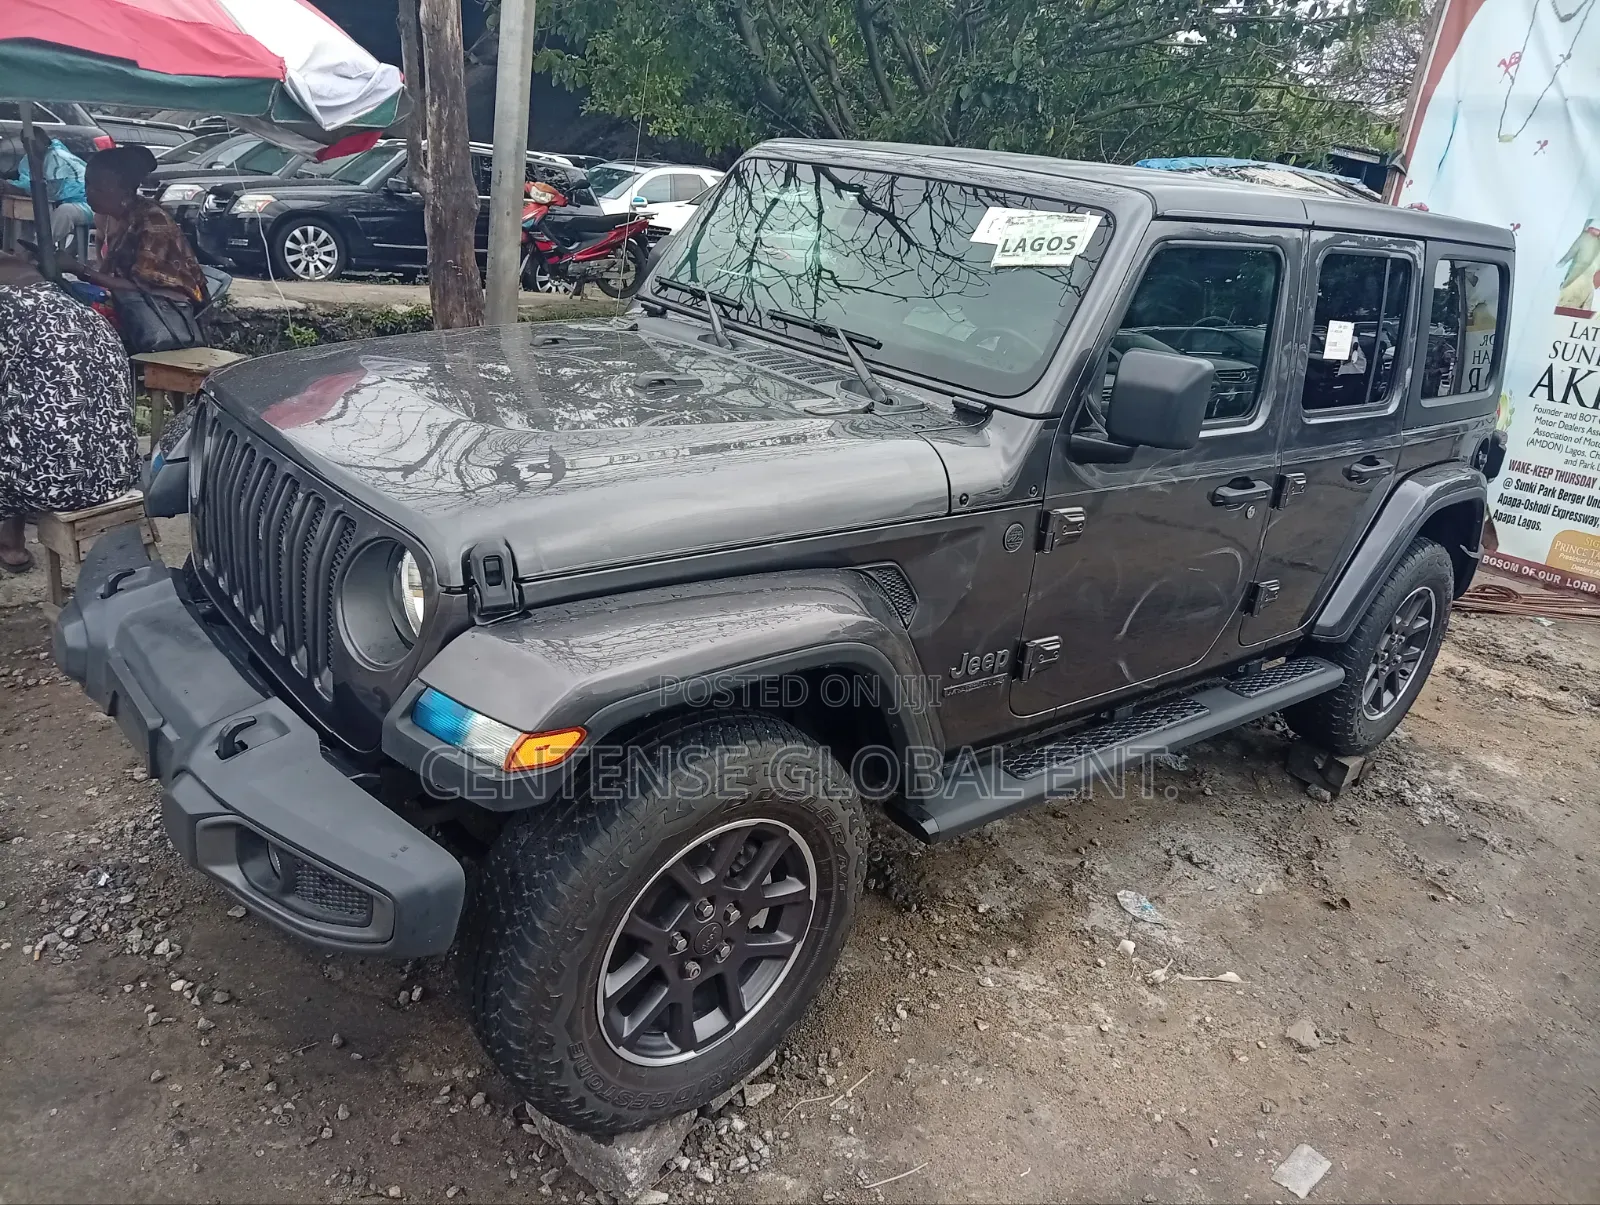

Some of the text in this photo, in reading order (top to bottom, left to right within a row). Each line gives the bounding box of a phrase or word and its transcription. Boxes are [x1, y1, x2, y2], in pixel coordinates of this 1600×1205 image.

[1000, 235, 1078, 253] LAGOS
[1533, 404, 1598, 424] Founder and BOT
[1534, 415, 1557, 428] Motor
[1558, 420, 1585, 434] Dealers
[1526, 436, 1564, 454] (AMDON)
[1533, 427, 1573, 443] Association
[1573, 435, 1583, 444] of
[1564, 458, 1578, 467] and
[1508, 459, 1598, 489] WAKE-KEEP THURSDAY
[1502, 477, 1514, 490] @
[1514, 478, 1538, 494] Sunki
[1537, 484, 1557, 499] Park
[1557, 488, 1586, 505] Berger
[1492, 508, 1542, 531] Apapa Lagos.
[1497, 492, 1600, 528] Apapa-Oshodi Expressway,
[1554, 540, 1587, 557] PRINCE
[1558, 552, 1587, 566] President
[1482, 555, 1599, 594] BOSOM OF OUR LORD.
[949, 649, 1010, 679] Jeep
[568, 1041, 750, 1110] BRIDGESTONE
